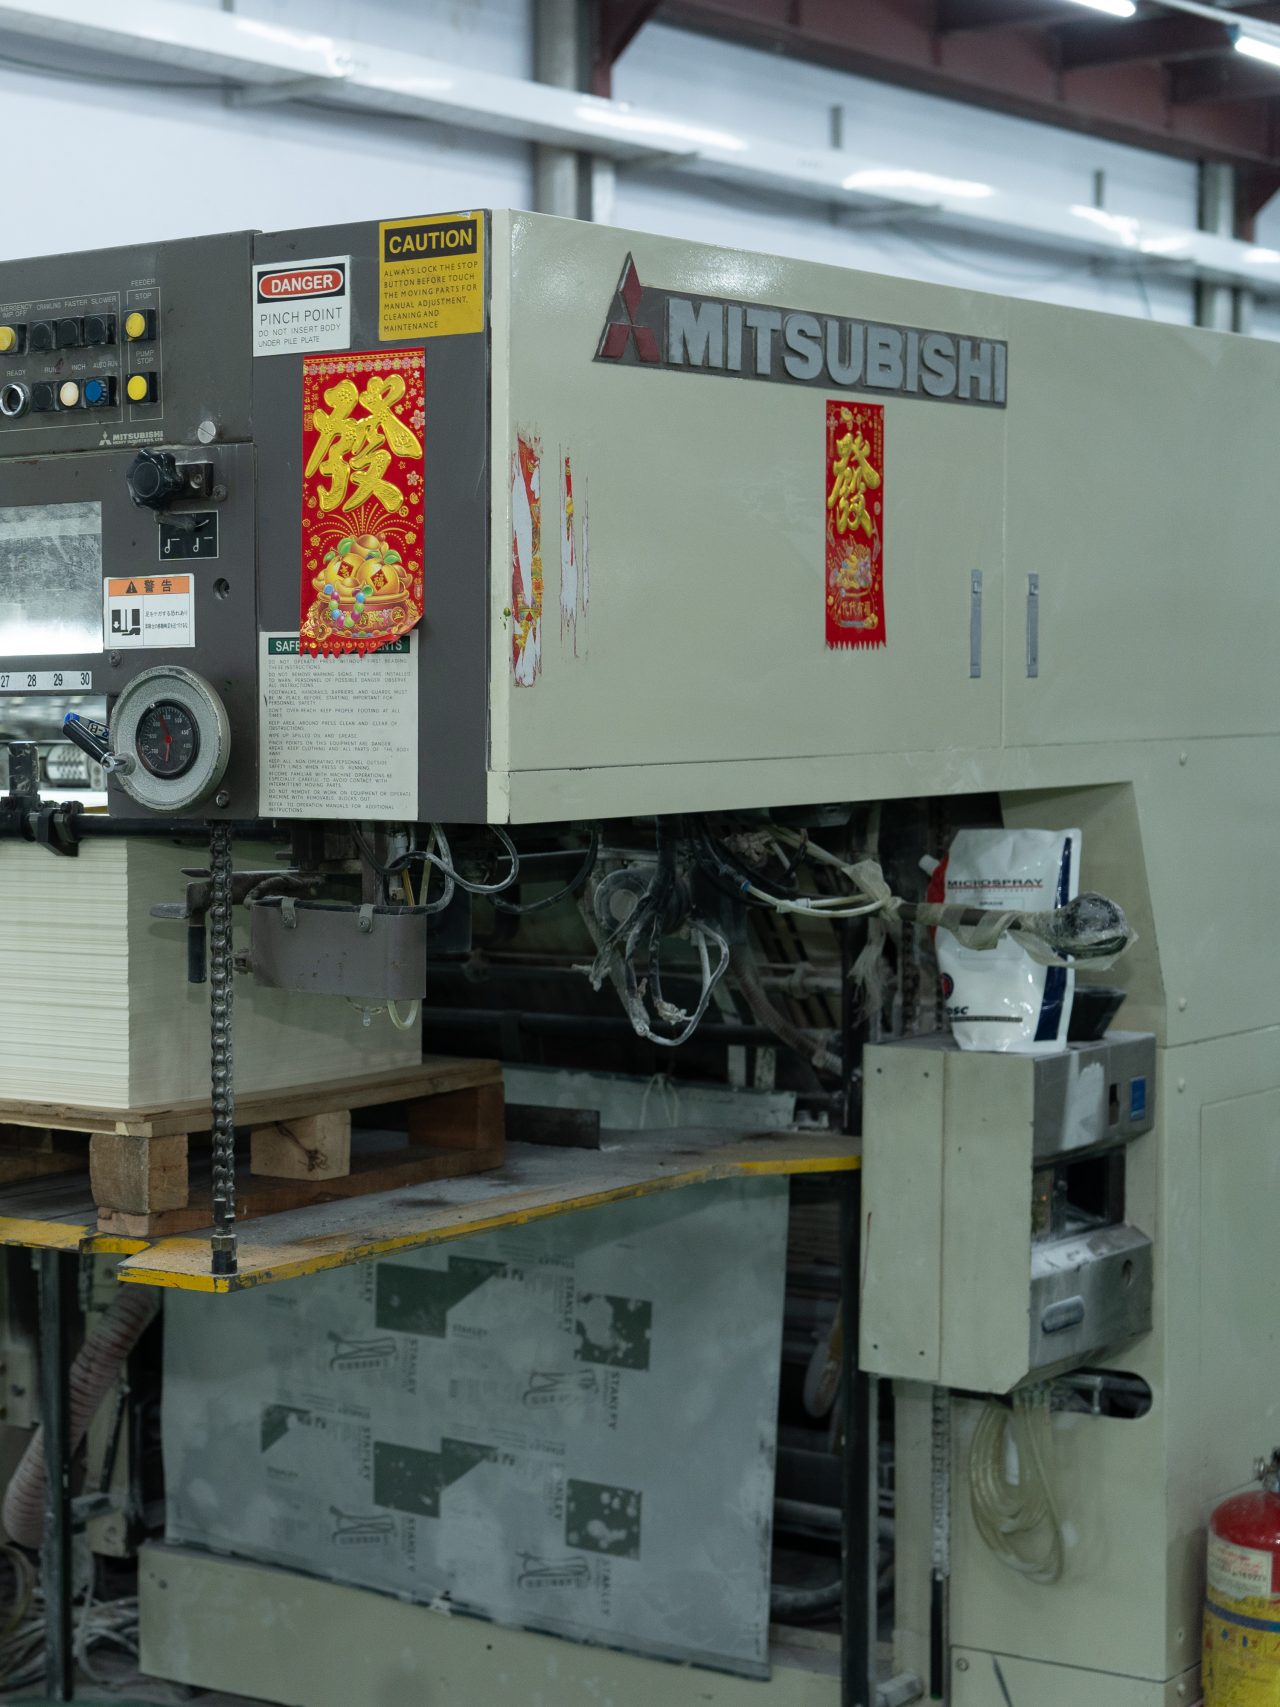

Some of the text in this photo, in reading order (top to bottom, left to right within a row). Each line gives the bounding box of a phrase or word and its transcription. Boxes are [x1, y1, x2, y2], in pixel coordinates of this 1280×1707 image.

[388, 228, 473, 254] CAUTION
[384, 261, 478, 277] ALWAYS LOCK THE STOP
[130, 278, 156, 287] FEEDER
[270, 274, 333, 293] DANGER
[384, 273, 475, 288] BUTTON BEFORE TOUCH
[135, 292, 152, 300] STOP
[384, 283, 477, 299] THE MOVING PARTS FOR
[64, 300, 88, 308] FASTER
[91, 296, 116, 304] SLOWER
[384, 301, 414, 310] MANUAL
[260, 307, 342, 326] PINCH POINT
[384, 309, 439, 321] CLEANING AND
[258, 323, 341, 338] DO NOT INSERT BODY
[384, 321, 439, 332] MAINTENANCE
[258, 336, 320, 348] UNDER PILE PLATE
[136, 350, 154, 358] PUMP
[666, 298, 1007, 403] MITSUBISHI
[136, 358, 154, 366] STOP
[6, 370, 26, 378] READY
[112, 430, 164, 440] MITSUBISHI
[144, 579, 173, 593] 警告
[275, 640, 300, 652] SAFE
[1, 675, 10, 688] 27
[28, 674, 37, 688] 28
[54, 674, 64, 687] 29
[80, 672, 90, 686] 30
[947, 878, 1043, 887] MICROSPRAY
[564, 1276, 574, 1335] STANLEY
[406, 1338, 418, 1396] STANLEY
[608, 1370, 620, 1431] STANLEY
